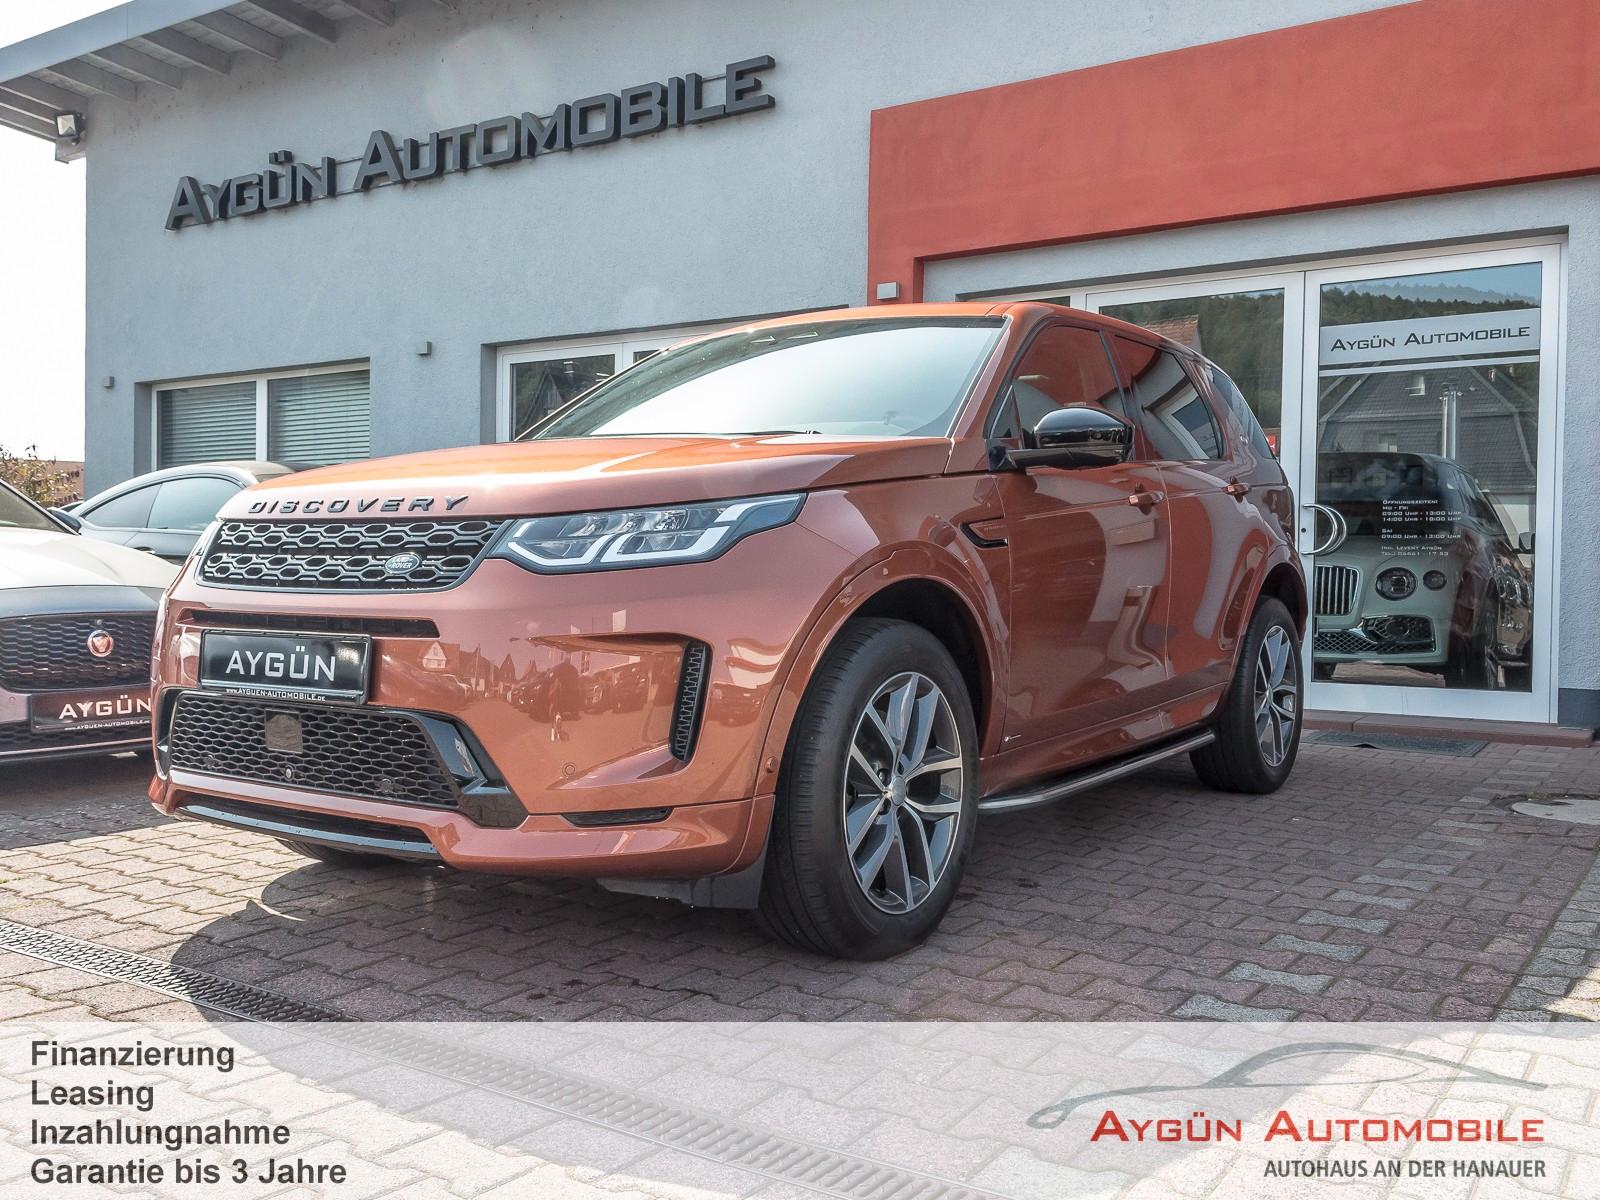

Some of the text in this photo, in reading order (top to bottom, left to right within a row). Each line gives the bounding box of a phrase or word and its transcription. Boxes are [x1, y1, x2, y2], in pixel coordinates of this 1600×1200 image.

[164, 55, 776, 231] AYGÜN AUTOMOBILE
[1330, 326, 1531, 352] AYGÜN AUTOMOBILE
[248, 495, 469, 514] DISCOVERY
[225, 645, 336, 682] AYGÜN
[58, 694, 152, 720] AYGÜN
